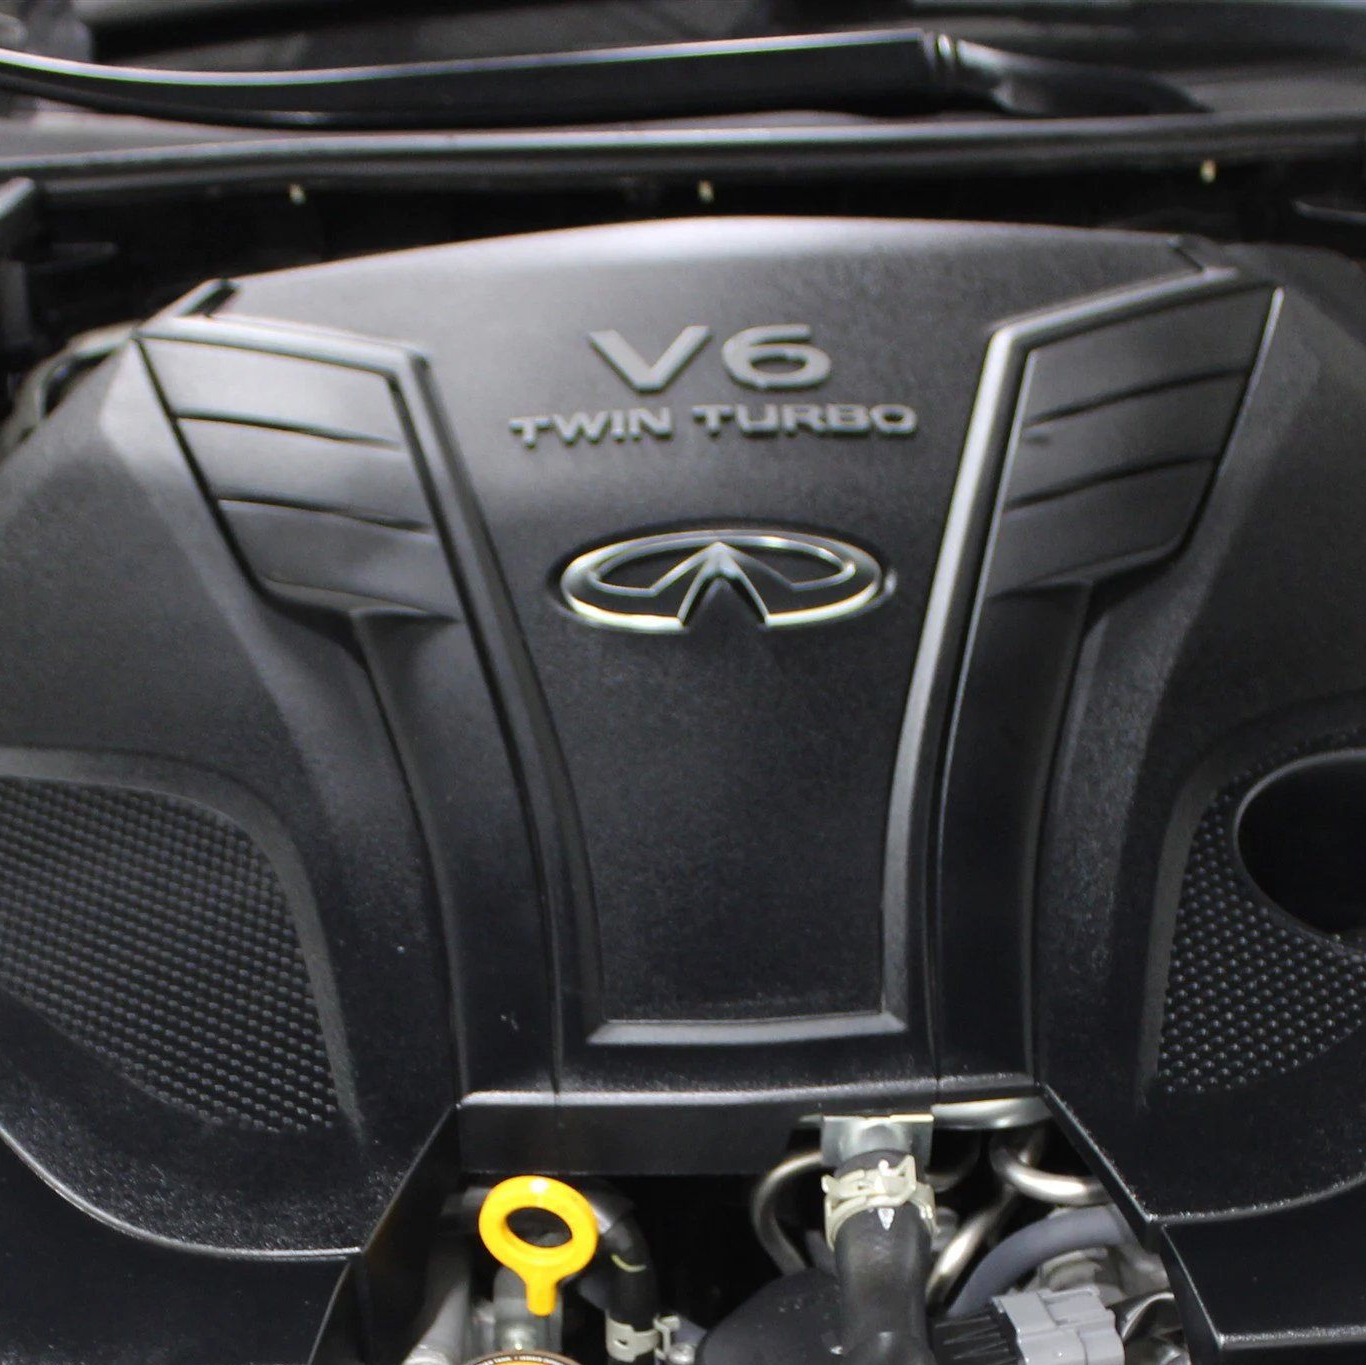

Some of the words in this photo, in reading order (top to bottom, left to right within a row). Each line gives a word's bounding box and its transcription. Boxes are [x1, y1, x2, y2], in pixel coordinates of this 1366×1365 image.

[587, 324, 832, 392] V6
[509, 406, 673, 449] TWIN
[691, 403, 918, 438] TURBO
